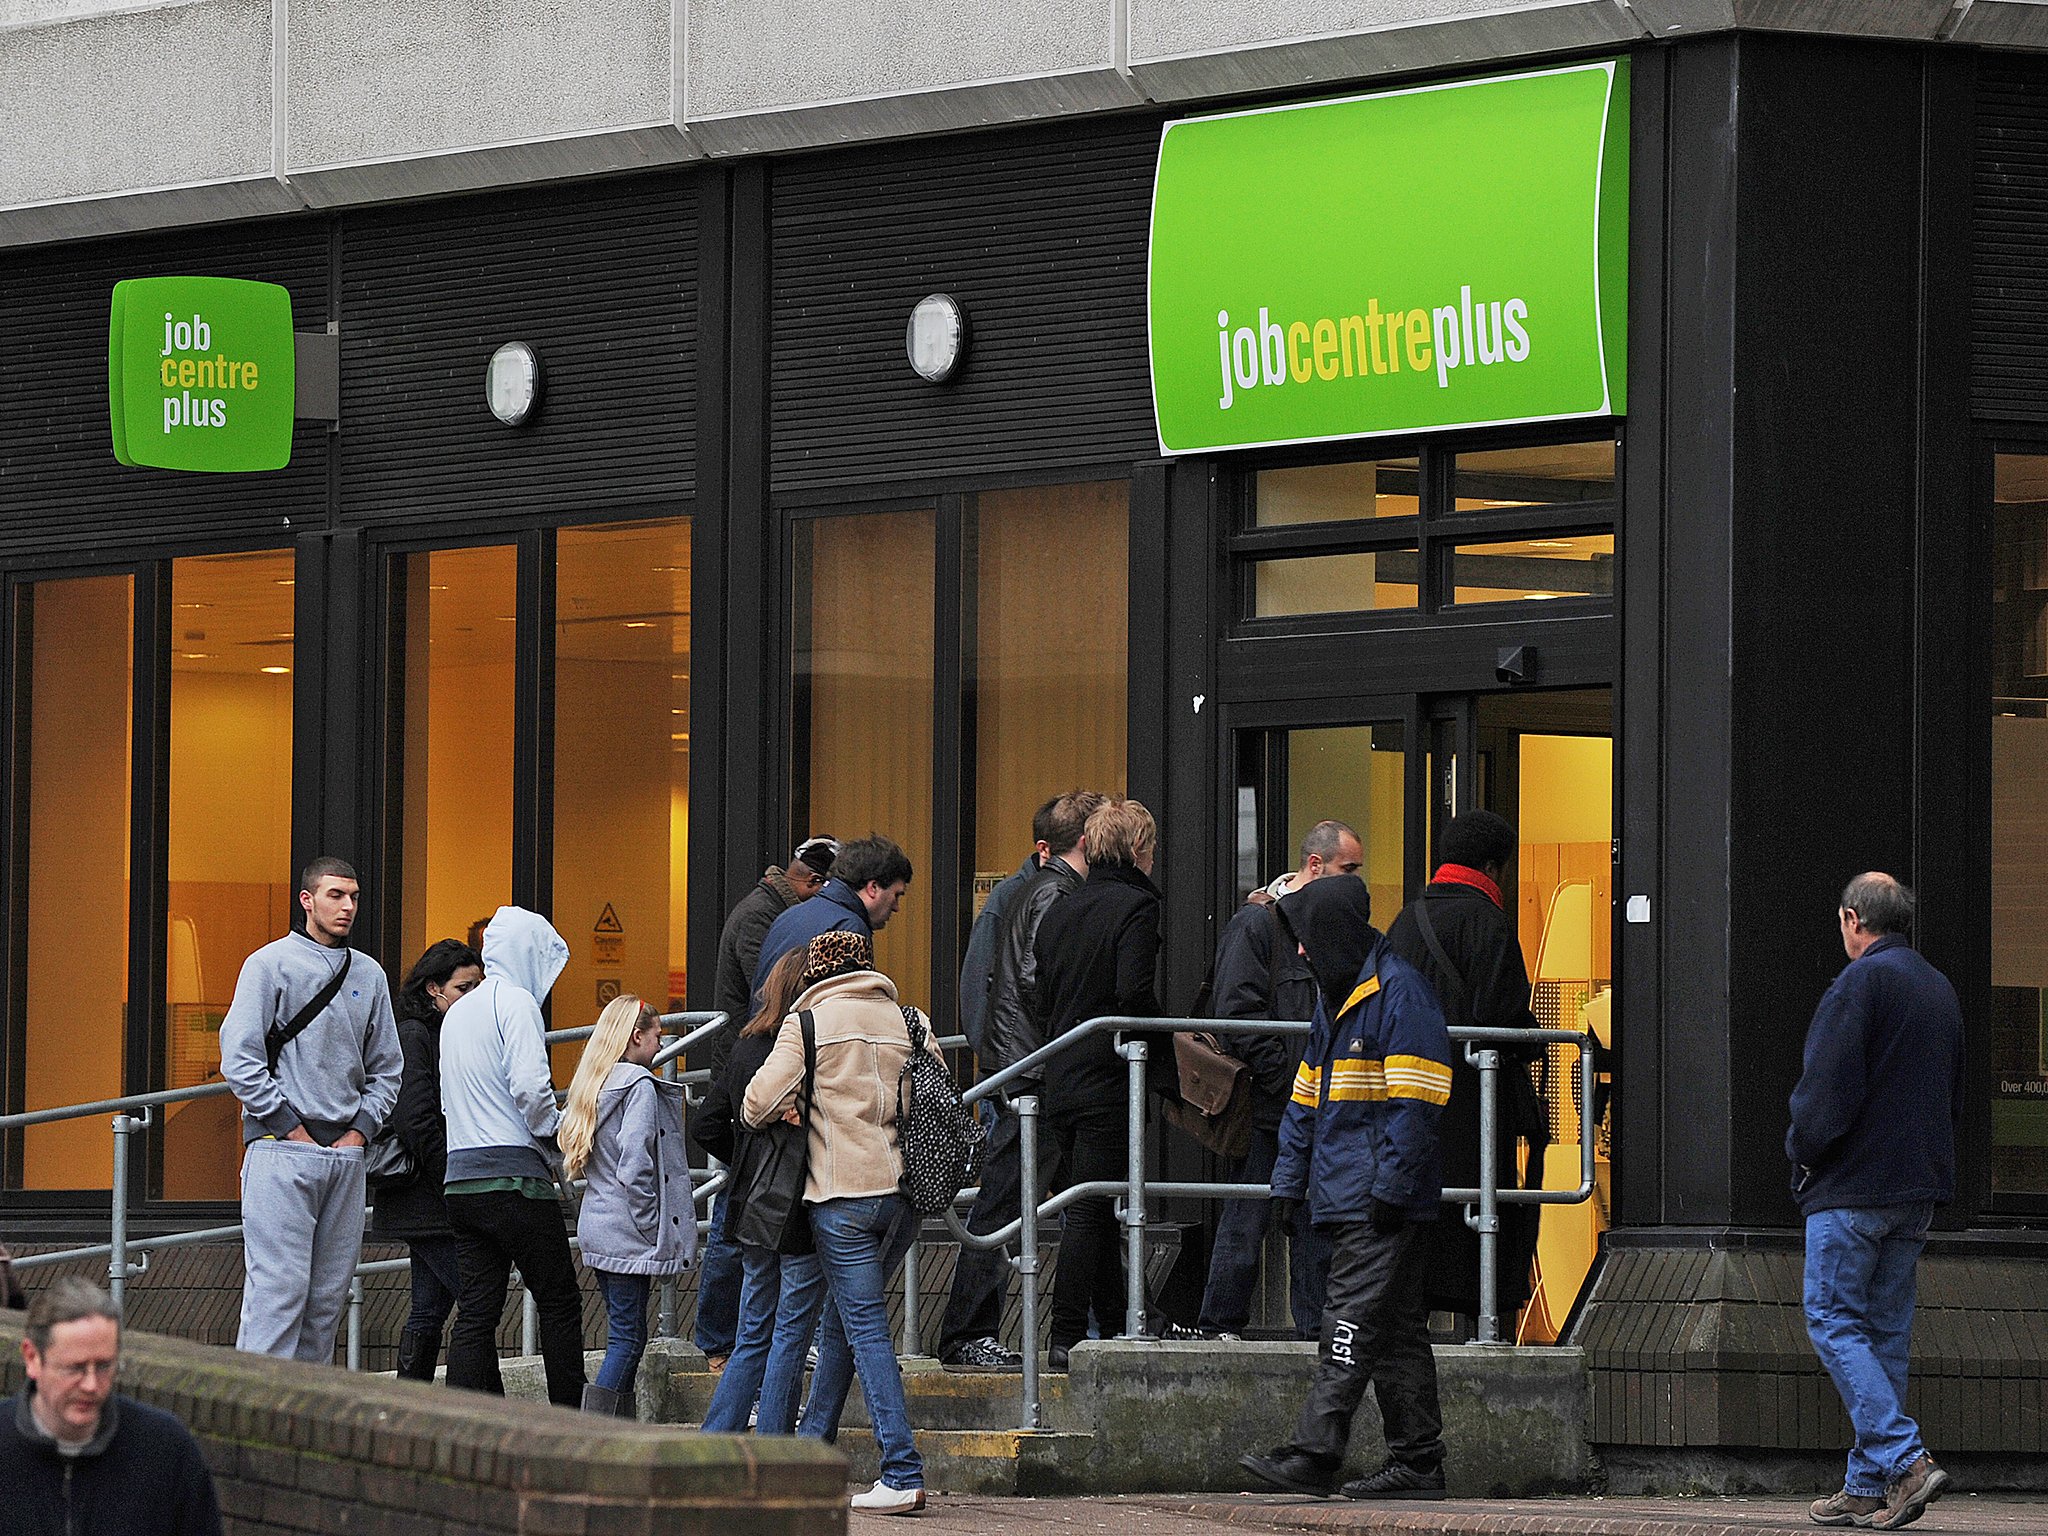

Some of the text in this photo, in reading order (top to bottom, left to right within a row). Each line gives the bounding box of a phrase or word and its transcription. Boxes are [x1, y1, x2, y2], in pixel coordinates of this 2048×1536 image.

[162, 312, 211, 356] job
[1217, 285, 1531, 410] jobcentreplus
[161, 354, 258, 390] centre
[163, 390, 227, 434] plus
[2001, 1081, 2023, 1093] Over
